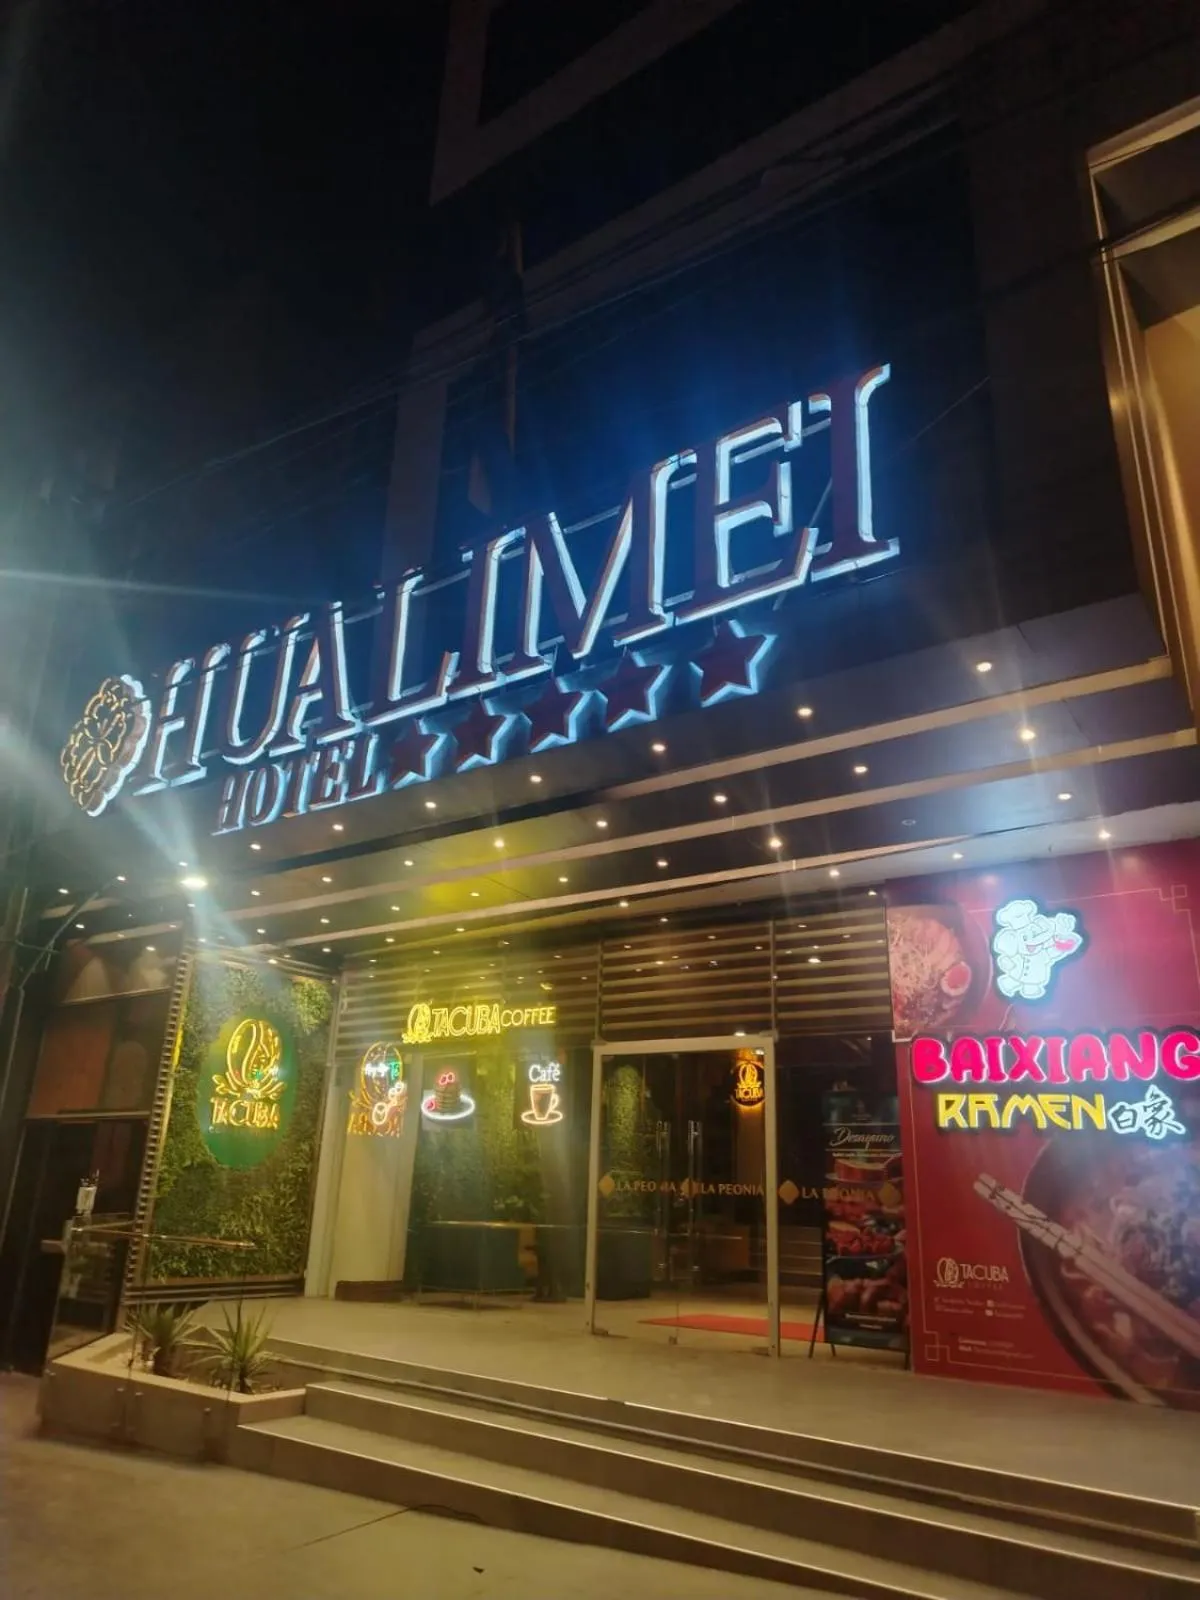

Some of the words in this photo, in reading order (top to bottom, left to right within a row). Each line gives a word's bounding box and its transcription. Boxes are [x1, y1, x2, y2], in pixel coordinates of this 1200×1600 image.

[131, 363, 900, 797] HUALIMEI
[210, 732, 387, 837] HOTEL
[432, 1003, 500, 1037] TACUBA
[500, 1006, 556, 1028] COFFEE
[528, 1061, 562, 1083] Café
[911, 1031, 1200, 1084] BAIXIANG
[937, 1092, 1107, 1131] RAMEN
[701, 1183, 715, 1196] LA
[718, 1183, 764, 1197] PEONIA
[802, 1186, 819, 1199] LA
[959, 1263, 1010, 1283] TACUBA
